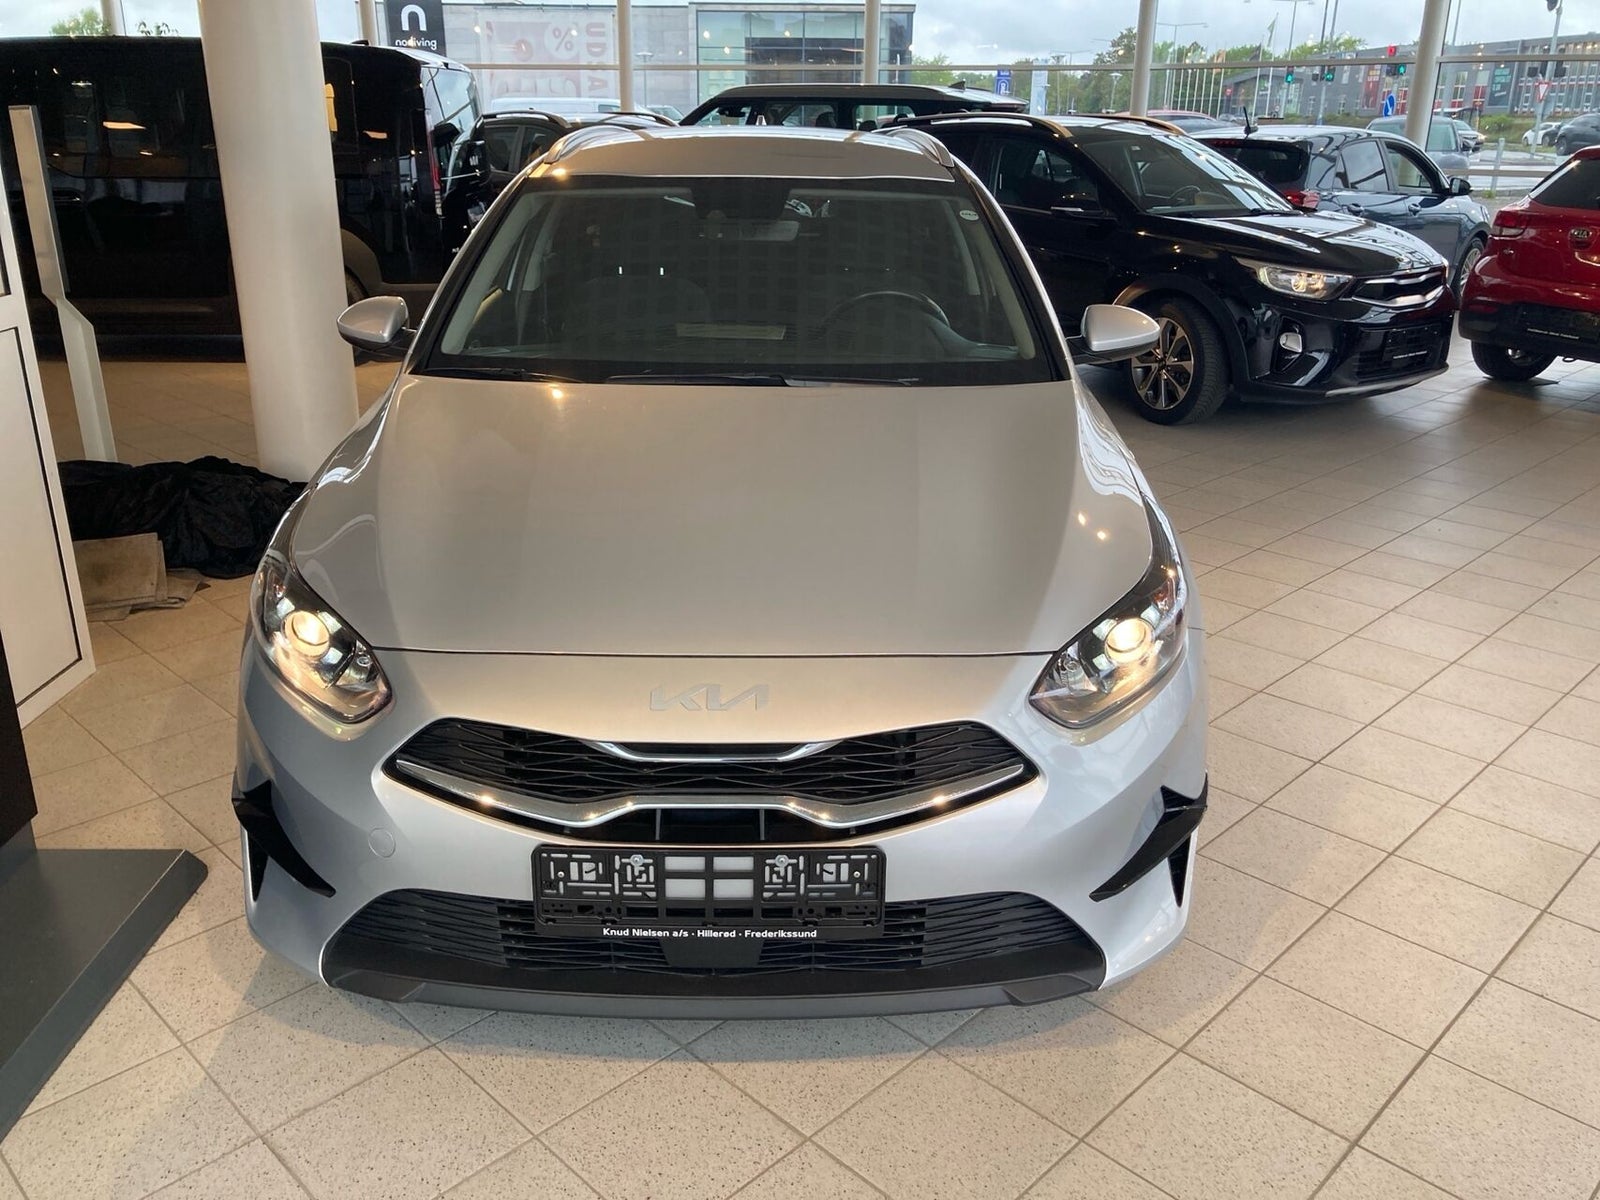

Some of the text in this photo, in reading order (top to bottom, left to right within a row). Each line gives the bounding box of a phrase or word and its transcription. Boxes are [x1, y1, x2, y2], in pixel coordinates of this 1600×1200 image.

[602, 927, 818, 938] Knud Nielsen a/s Hillerød Frederikssund
